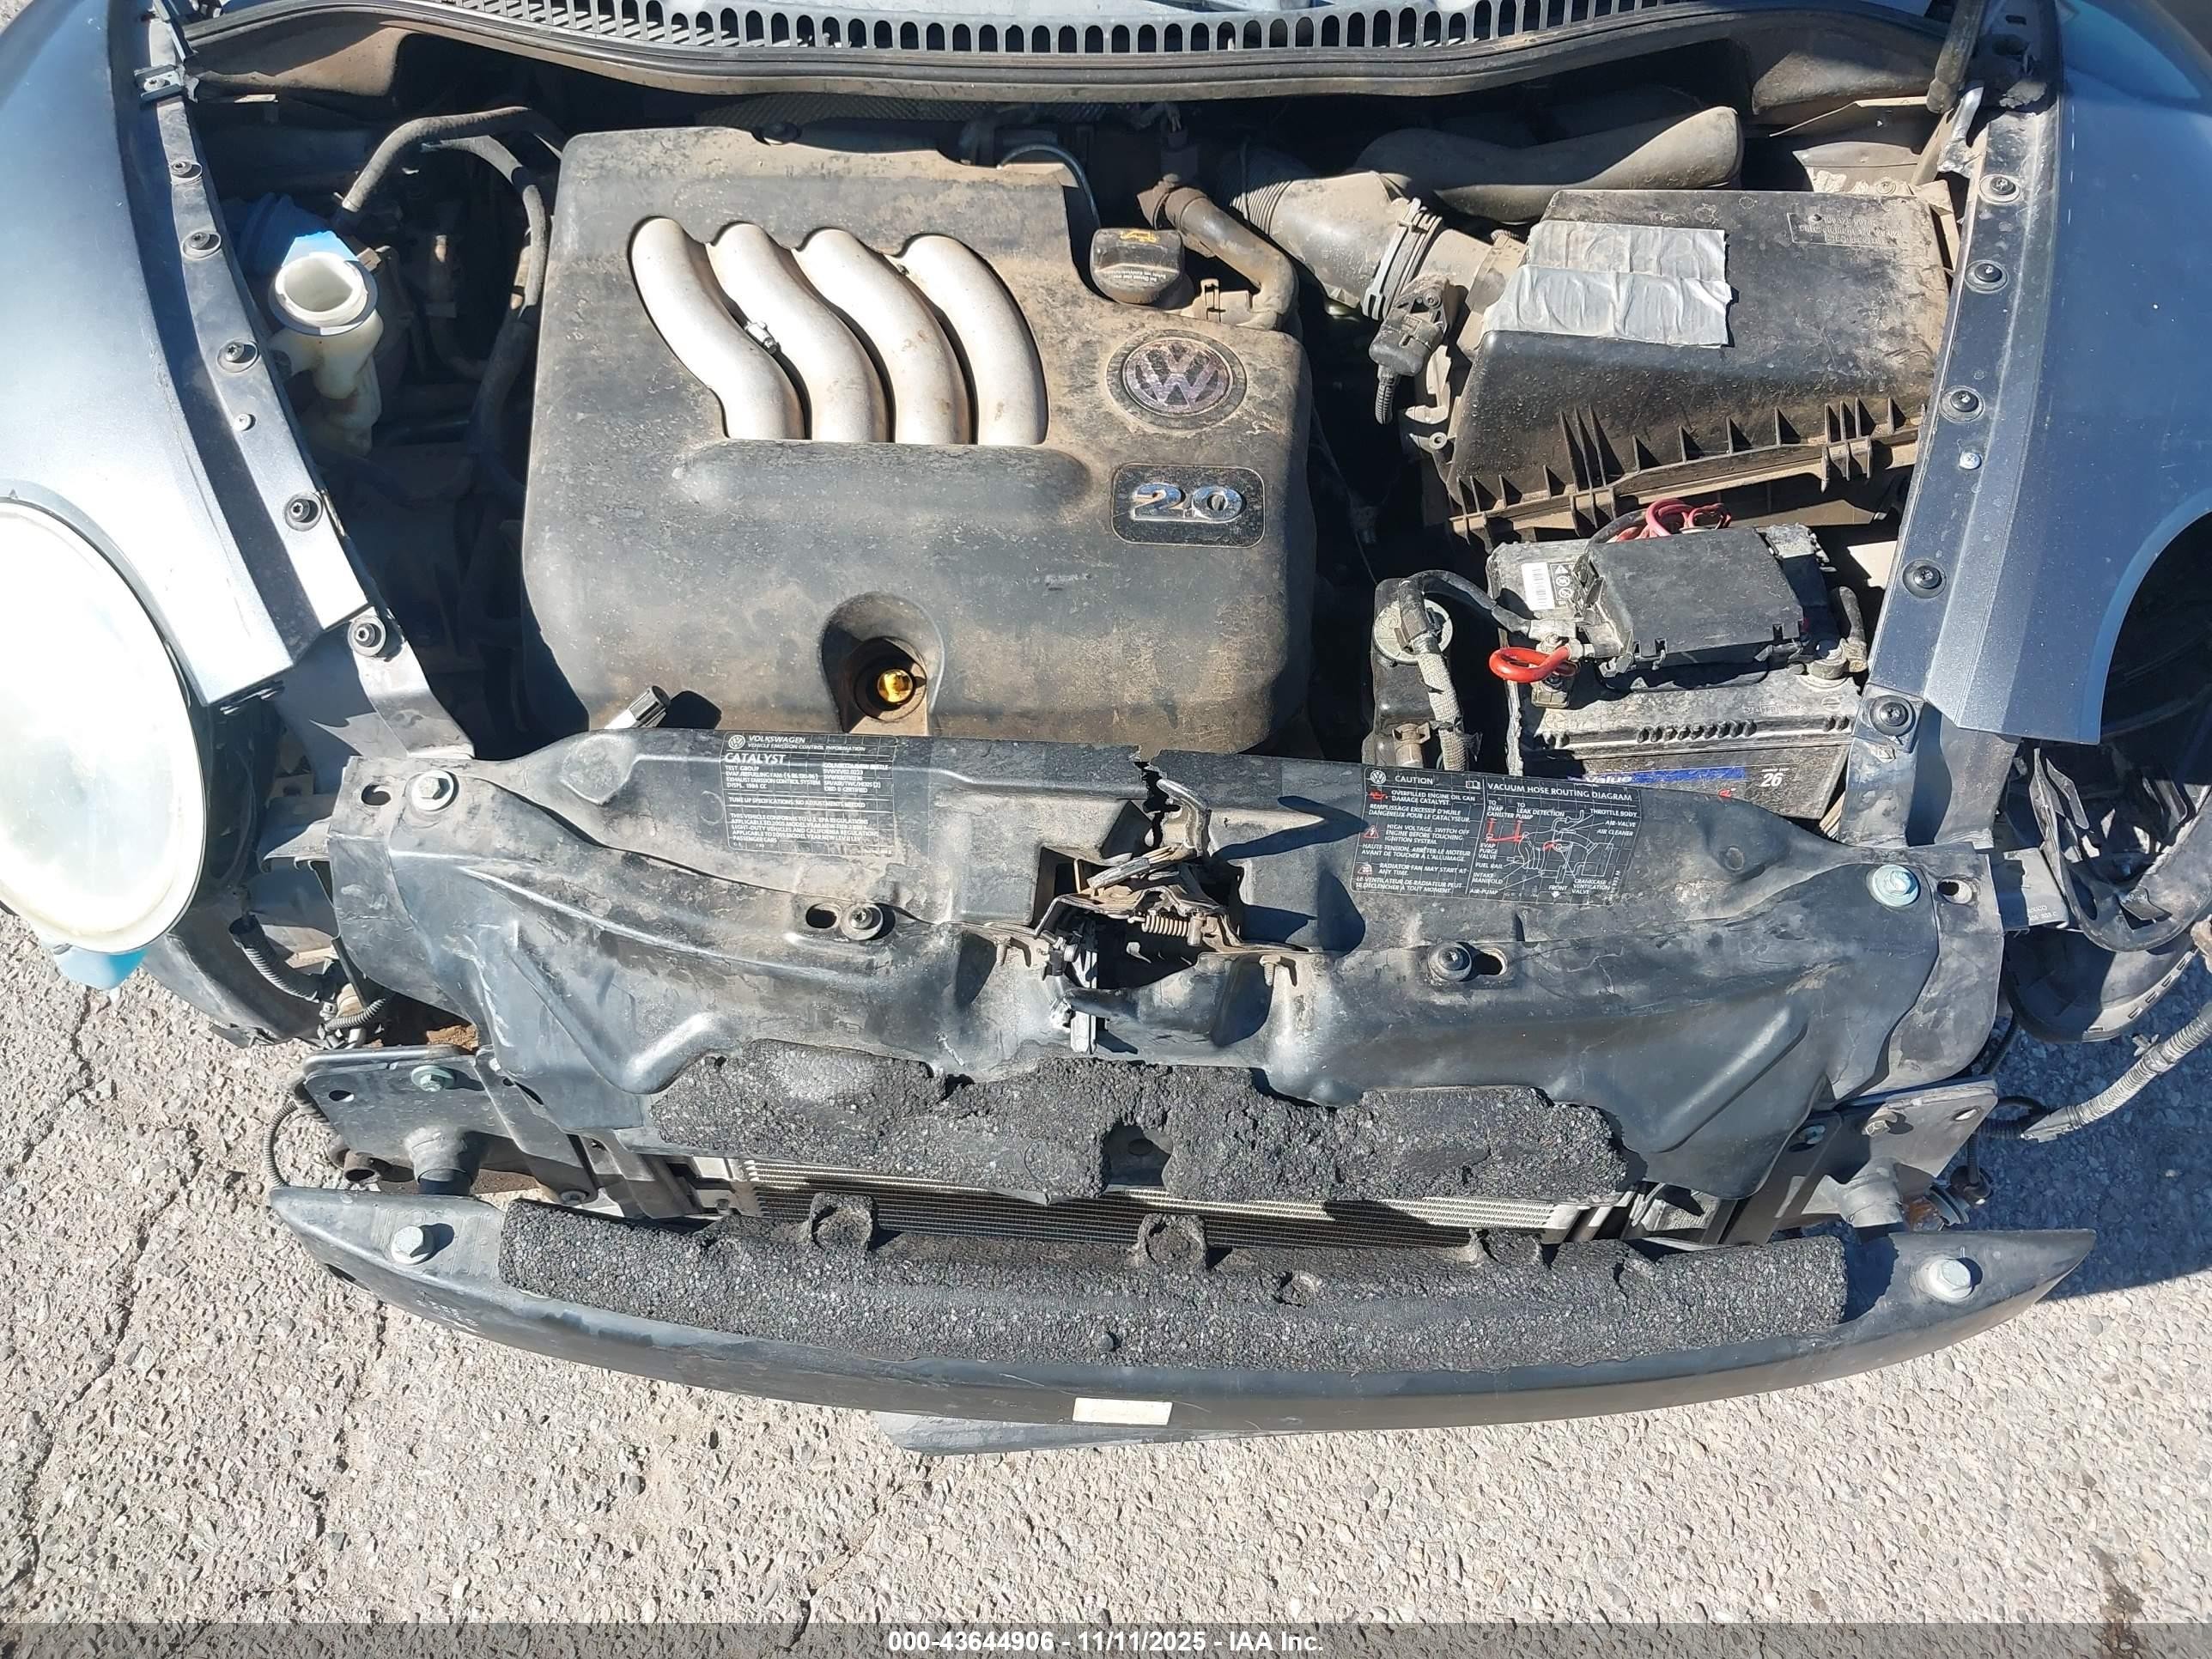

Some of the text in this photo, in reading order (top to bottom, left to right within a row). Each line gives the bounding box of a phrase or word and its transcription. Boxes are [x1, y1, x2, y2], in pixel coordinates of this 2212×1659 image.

[750, 735, 805, 744] VOLKSWAGEN
[724, 753, 787, 764] CATALYST
[1395, 775, 1434, 785] CAUTION
[1586, 775, 1632, 784] Value
[1760, 772, 1784, 787] 26
[1487, 783, 1525, 792] VACUUM
[1551, 788, 1590, 798] ROUTING
[1591, 792, 1633, 801] DIAGRAM
[1532, 809, 1565, 817] DETECTION
[1472, 877, 1504, 885] MANIFOLD
[1572, 883, 1610, 891] VENTILATION
